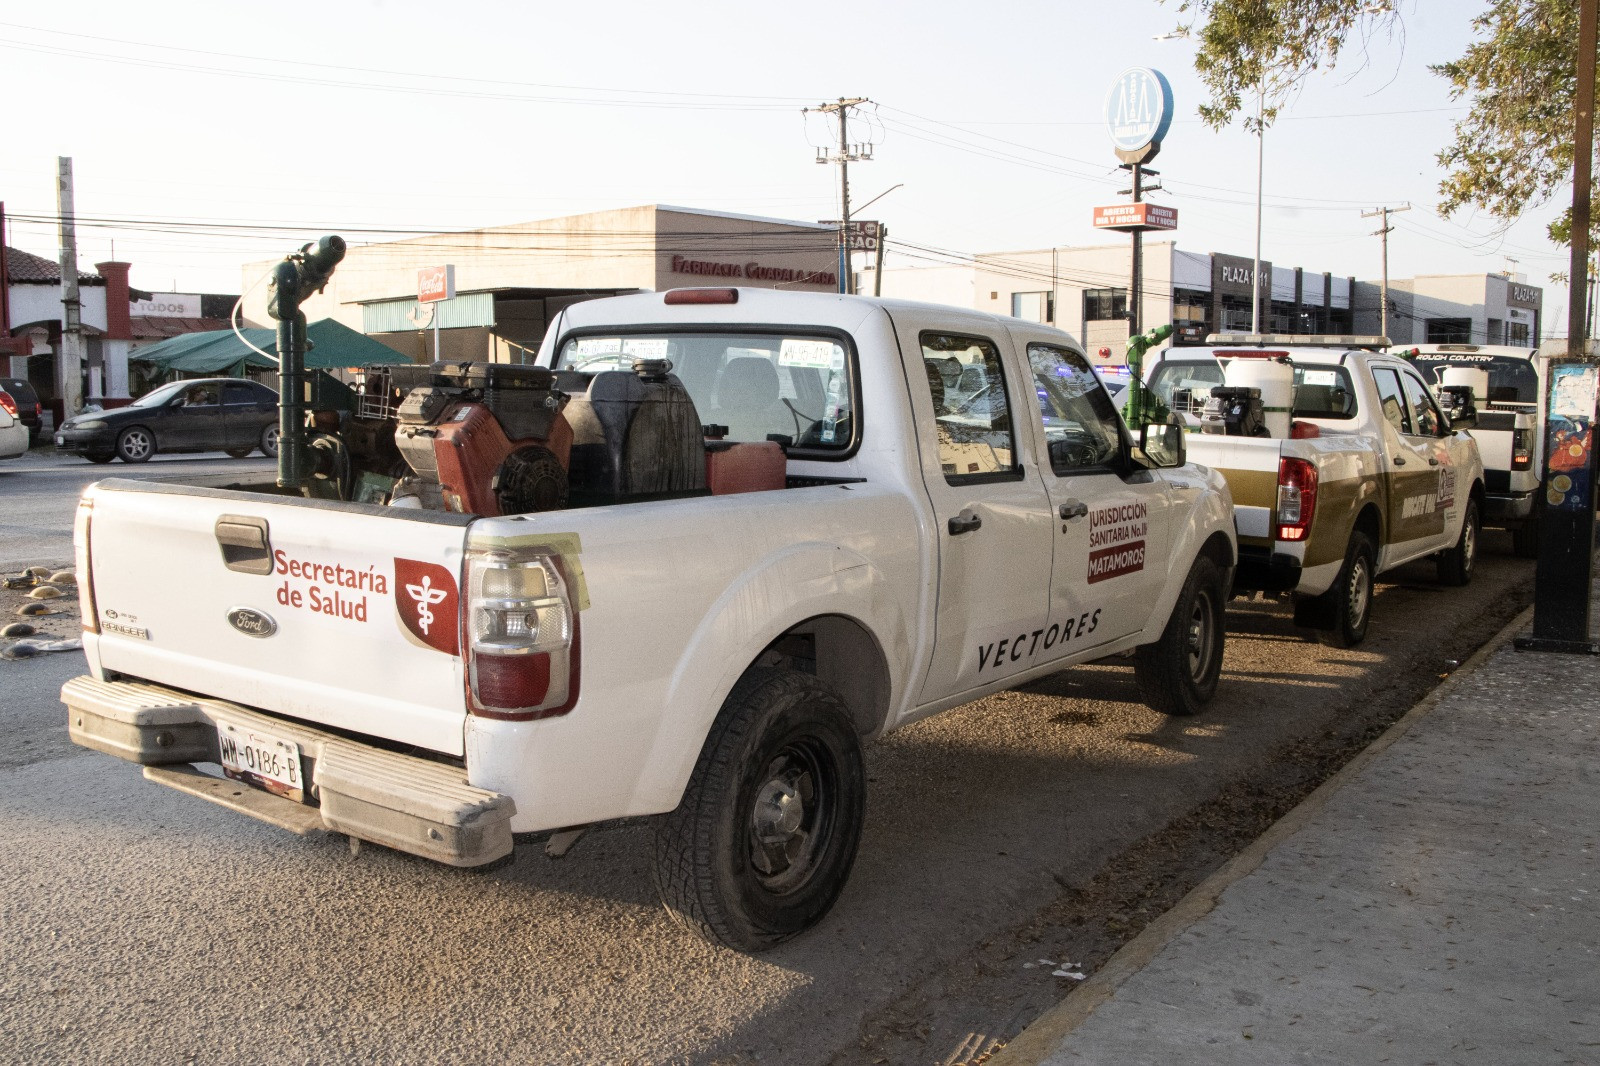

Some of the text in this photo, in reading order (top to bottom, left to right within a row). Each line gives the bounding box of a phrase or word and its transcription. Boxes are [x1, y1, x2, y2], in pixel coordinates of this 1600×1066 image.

[1103, 207, 1135, 216] ABIERTO
[1116, 215, 1142, 224] NOCHE
[1152, 208, 1172, 218] ABIERTO
[1160, 219, 1177, 227] NOCHE
[671, 254, 837, 285] FARMACIA GUADALAJARA
[1222, 266, 1250, 285] PLAZA
[140, 303, 185, 314] TODOS
[1089, 498, 1147, 533] JURISDICCIÓN
[1090, 525, 1130, 547] SANITARIA
[275, 549, 388, 594] Secretaría
[1089, 548, 1144, 577] MATAMOROS
[276, 581, 367, 622] de Salud
[101, 621, 146, 638] RANGER
[236, 611, 263, 632] Ford
[978, 608, 1102, 673] VECTORES
[220, 734, 297, 783] WM-0186-B
